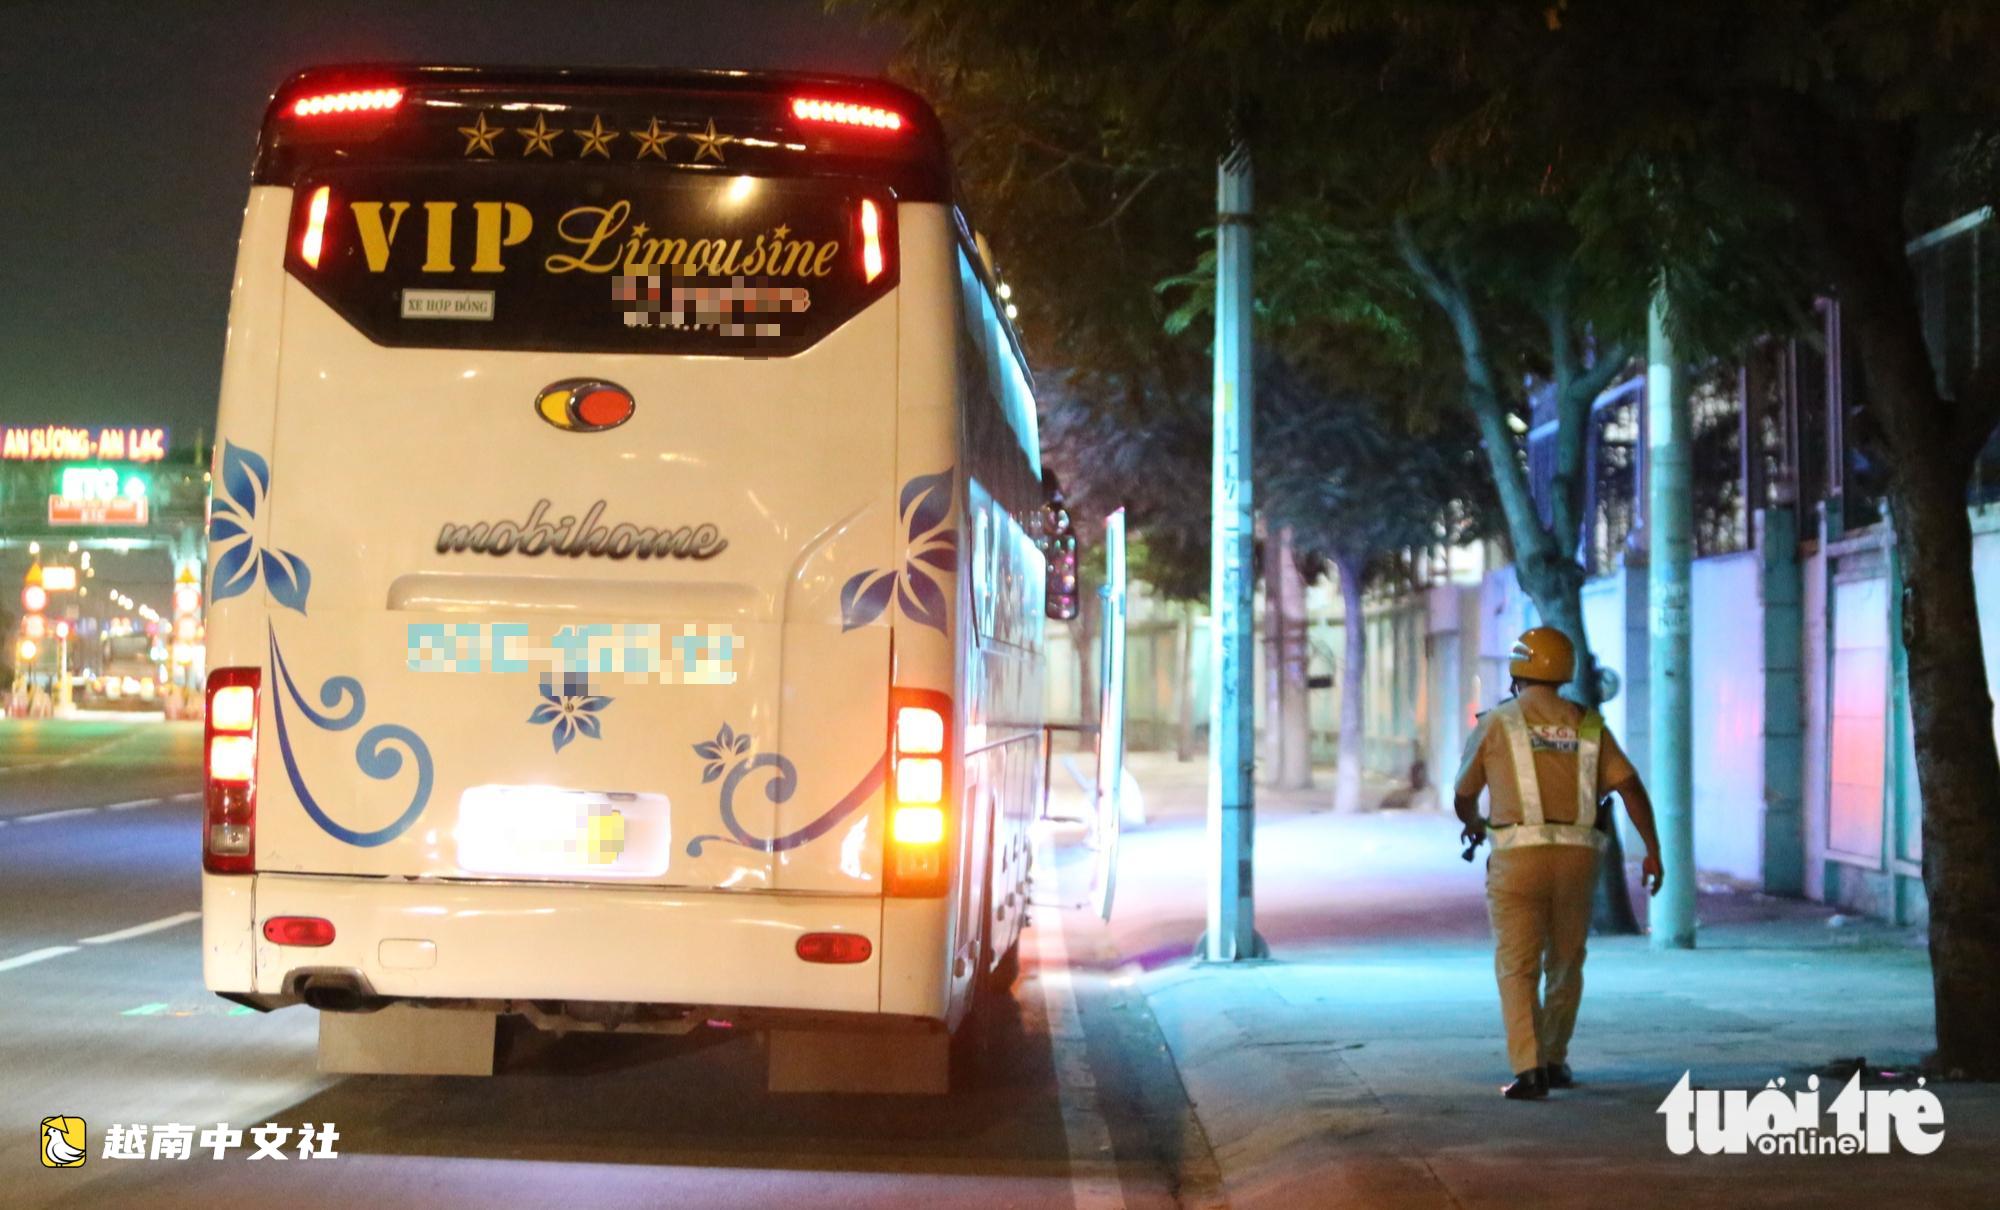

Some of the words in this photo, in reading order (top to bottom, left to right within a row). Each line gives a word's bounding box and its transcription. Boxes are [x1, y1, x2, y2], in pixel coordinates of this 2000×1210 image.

[350, 201, 533, 273] VIP
[545, 199, 839, 277] Limousine
[408, 299, 423, 312] XE
[426, 299, 452, 313] HỢP
[2, 428, 29, 459] AN
[98, 428, 125, 459] AN
[128, 428, 165, 463] LẠC
[434, 498, 730, 561] mobihome
